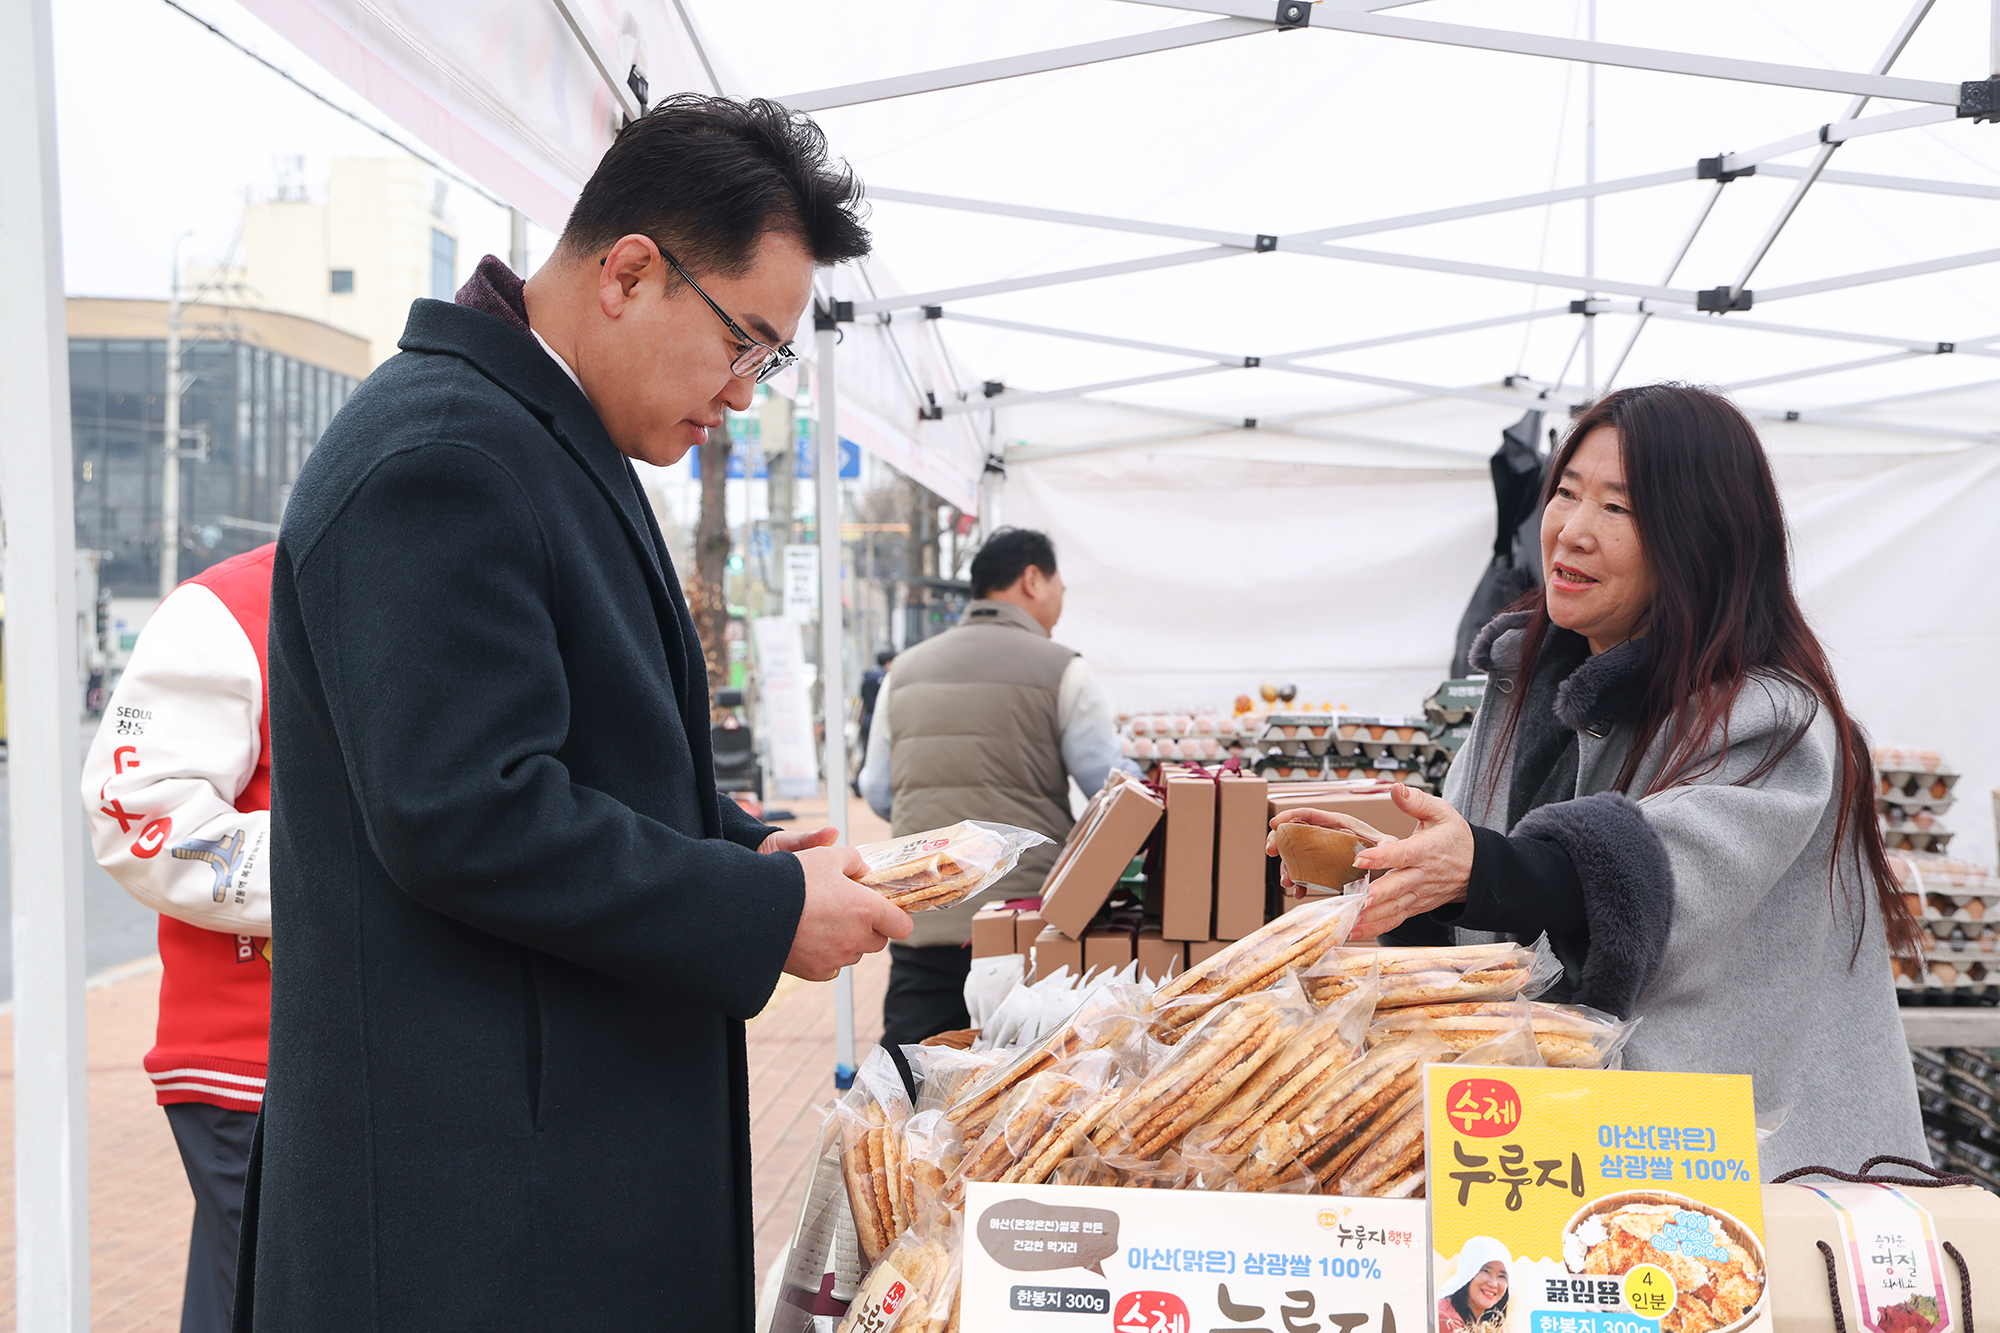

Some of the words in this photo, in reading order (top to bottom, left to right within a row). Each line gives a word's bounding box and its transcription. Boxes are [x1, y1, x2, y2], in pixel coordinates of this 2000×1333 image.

[116, 706, 153, 720] SEOUL
[116, 719, 147, 736] 창동
[1450, 1081, 1517, 1131] 수제
[1598, 1124, 1716, 1153] 아산(맑은)
[1448, 1140, 1585, 1211] 누룽지
[1599, 1154, 1674, 1180] 삼광쌀
[1681, 1158, 1750, 1182] 100%
[989, 1218, 1080, 1233] 아산(온양온천)쌀로
[1082, 1221, 1104, 1234] 만든
[1013, 1239, 1044, 1252] 건강한
[1047, 1241, 1078, 1254] 먹거리
[1875, 1234, 1906, 1249] 즐거운
[1128, 1247, 1236, 1274] 아산(맑은)
[1243, 1252, 1312, 1278] 삼광쌀
[1318, 1257, 1381, 1280] 100%
[1871, 1247, 1917, 1278] 명절
[1642, 1271, 1653, 1286] 4
[1016, 1289, 1061, 1308] 한봉지
[1065, 1294, 1104, 1312] 300g
[1545, 1278, 1621, 1305] 끓임용
[1631, 1292, 1667, 1311] 인분
